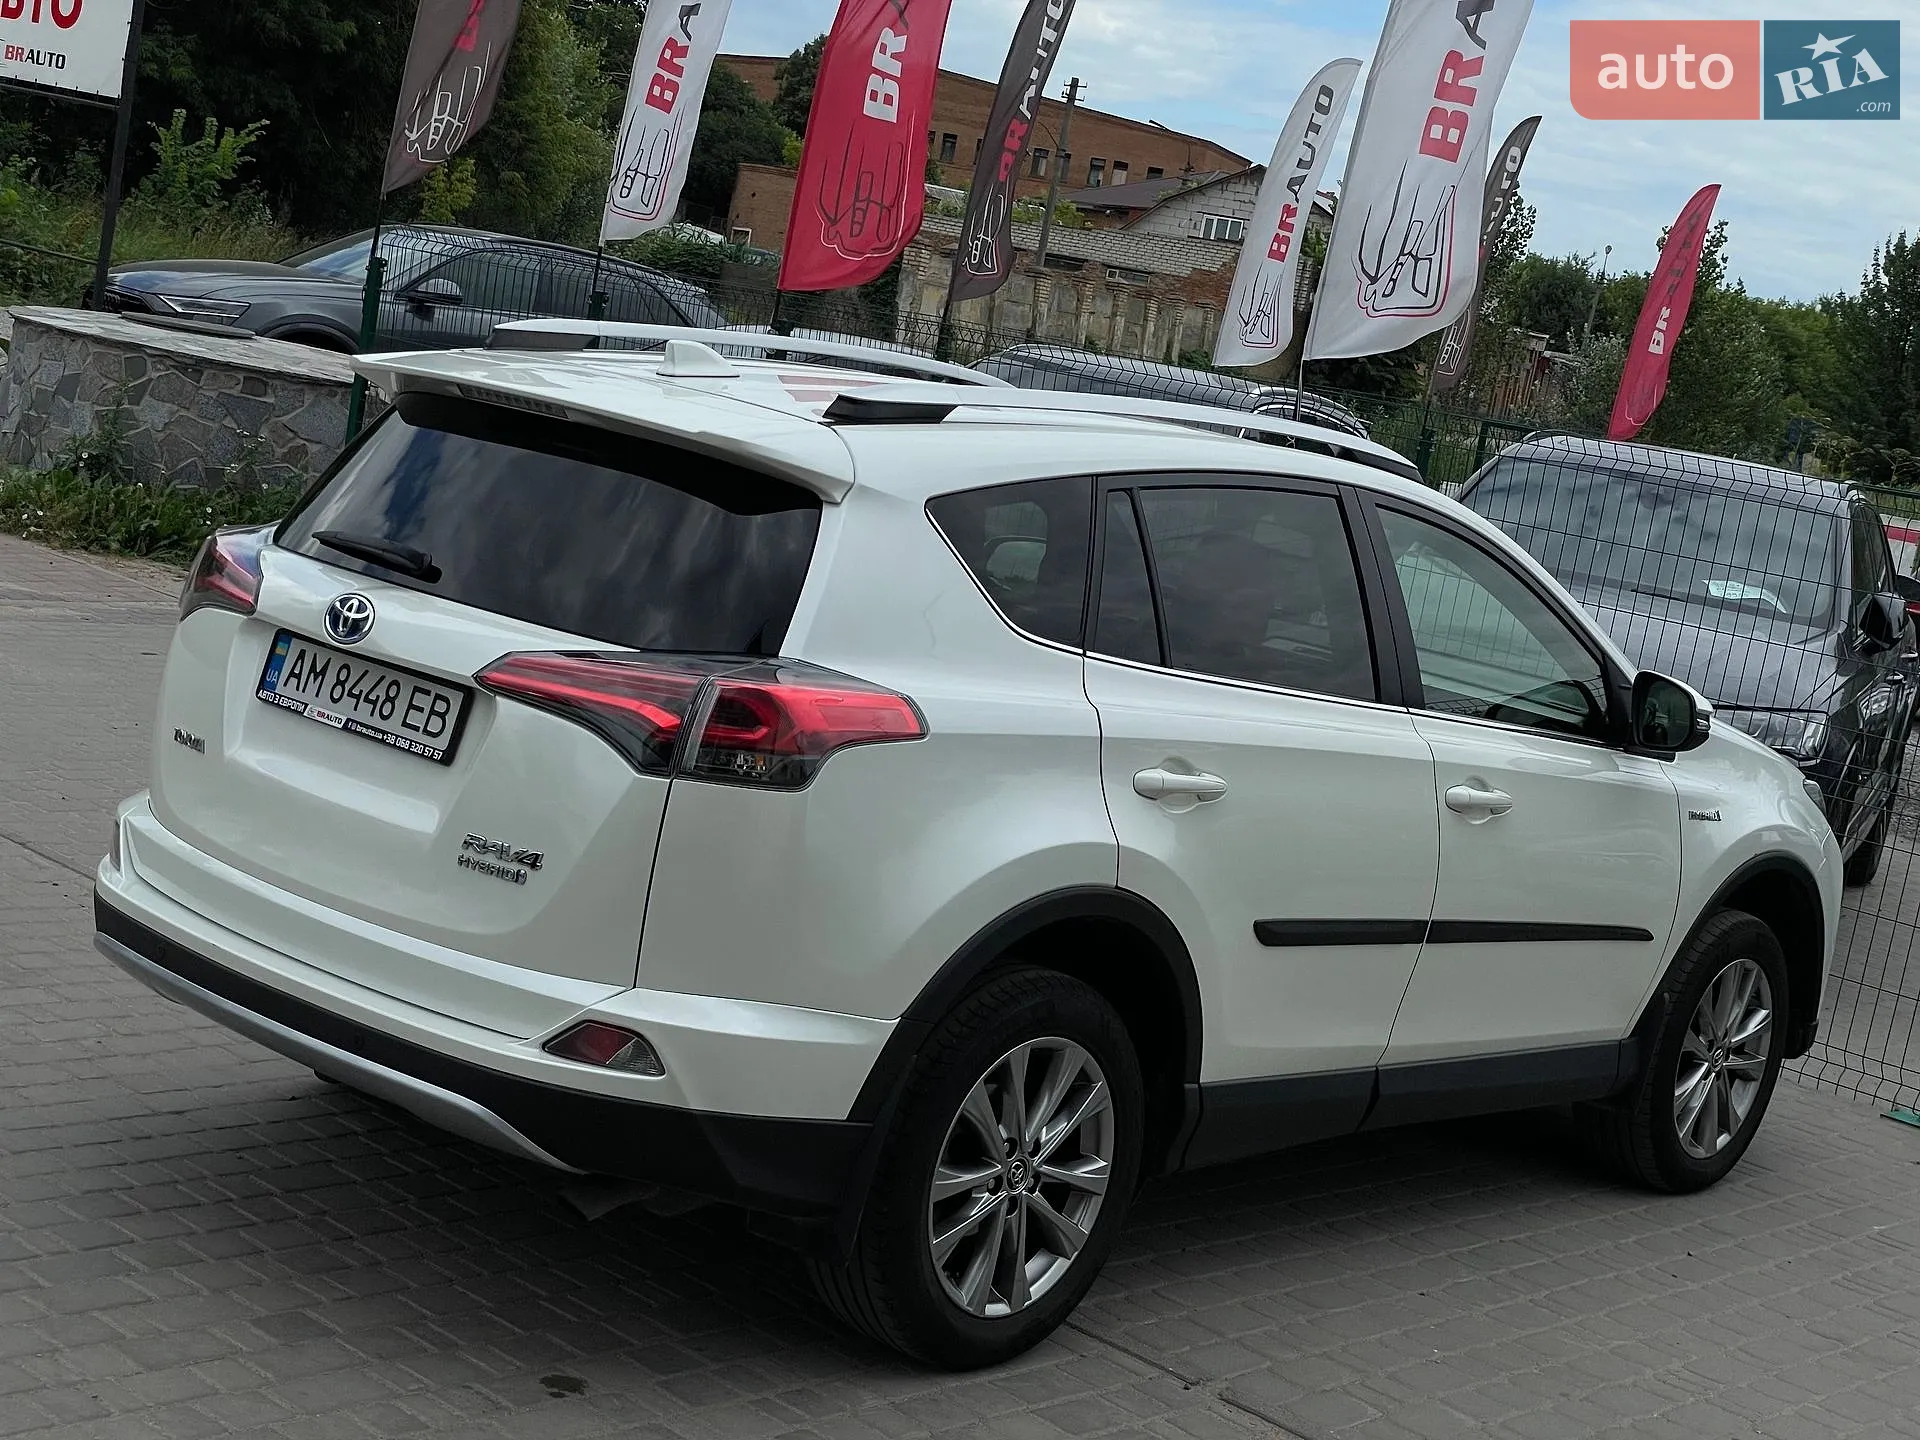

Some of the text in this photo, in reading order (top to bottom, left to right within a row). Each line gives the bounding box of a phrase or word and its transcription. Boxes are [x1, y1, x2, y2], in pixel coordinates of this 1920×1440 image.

[4, 44, 66, 70] BRAUTO
[1267, 84, 1334, 263] BRAUTO
[266, 668, 279, 684] UA
[283, 648, 451, 738] AM 8448 EB
[316, 710, 343, 725] BRAUTO
[395, 738, 411, 750] 068
[410, 742, 423, 754] 320
[423, 747, 434, 758] 57
[433, 750, 443, 761] 57
[462, 832, 545, 871] RAV4
[457, 853, 521, 884] HYBRID
